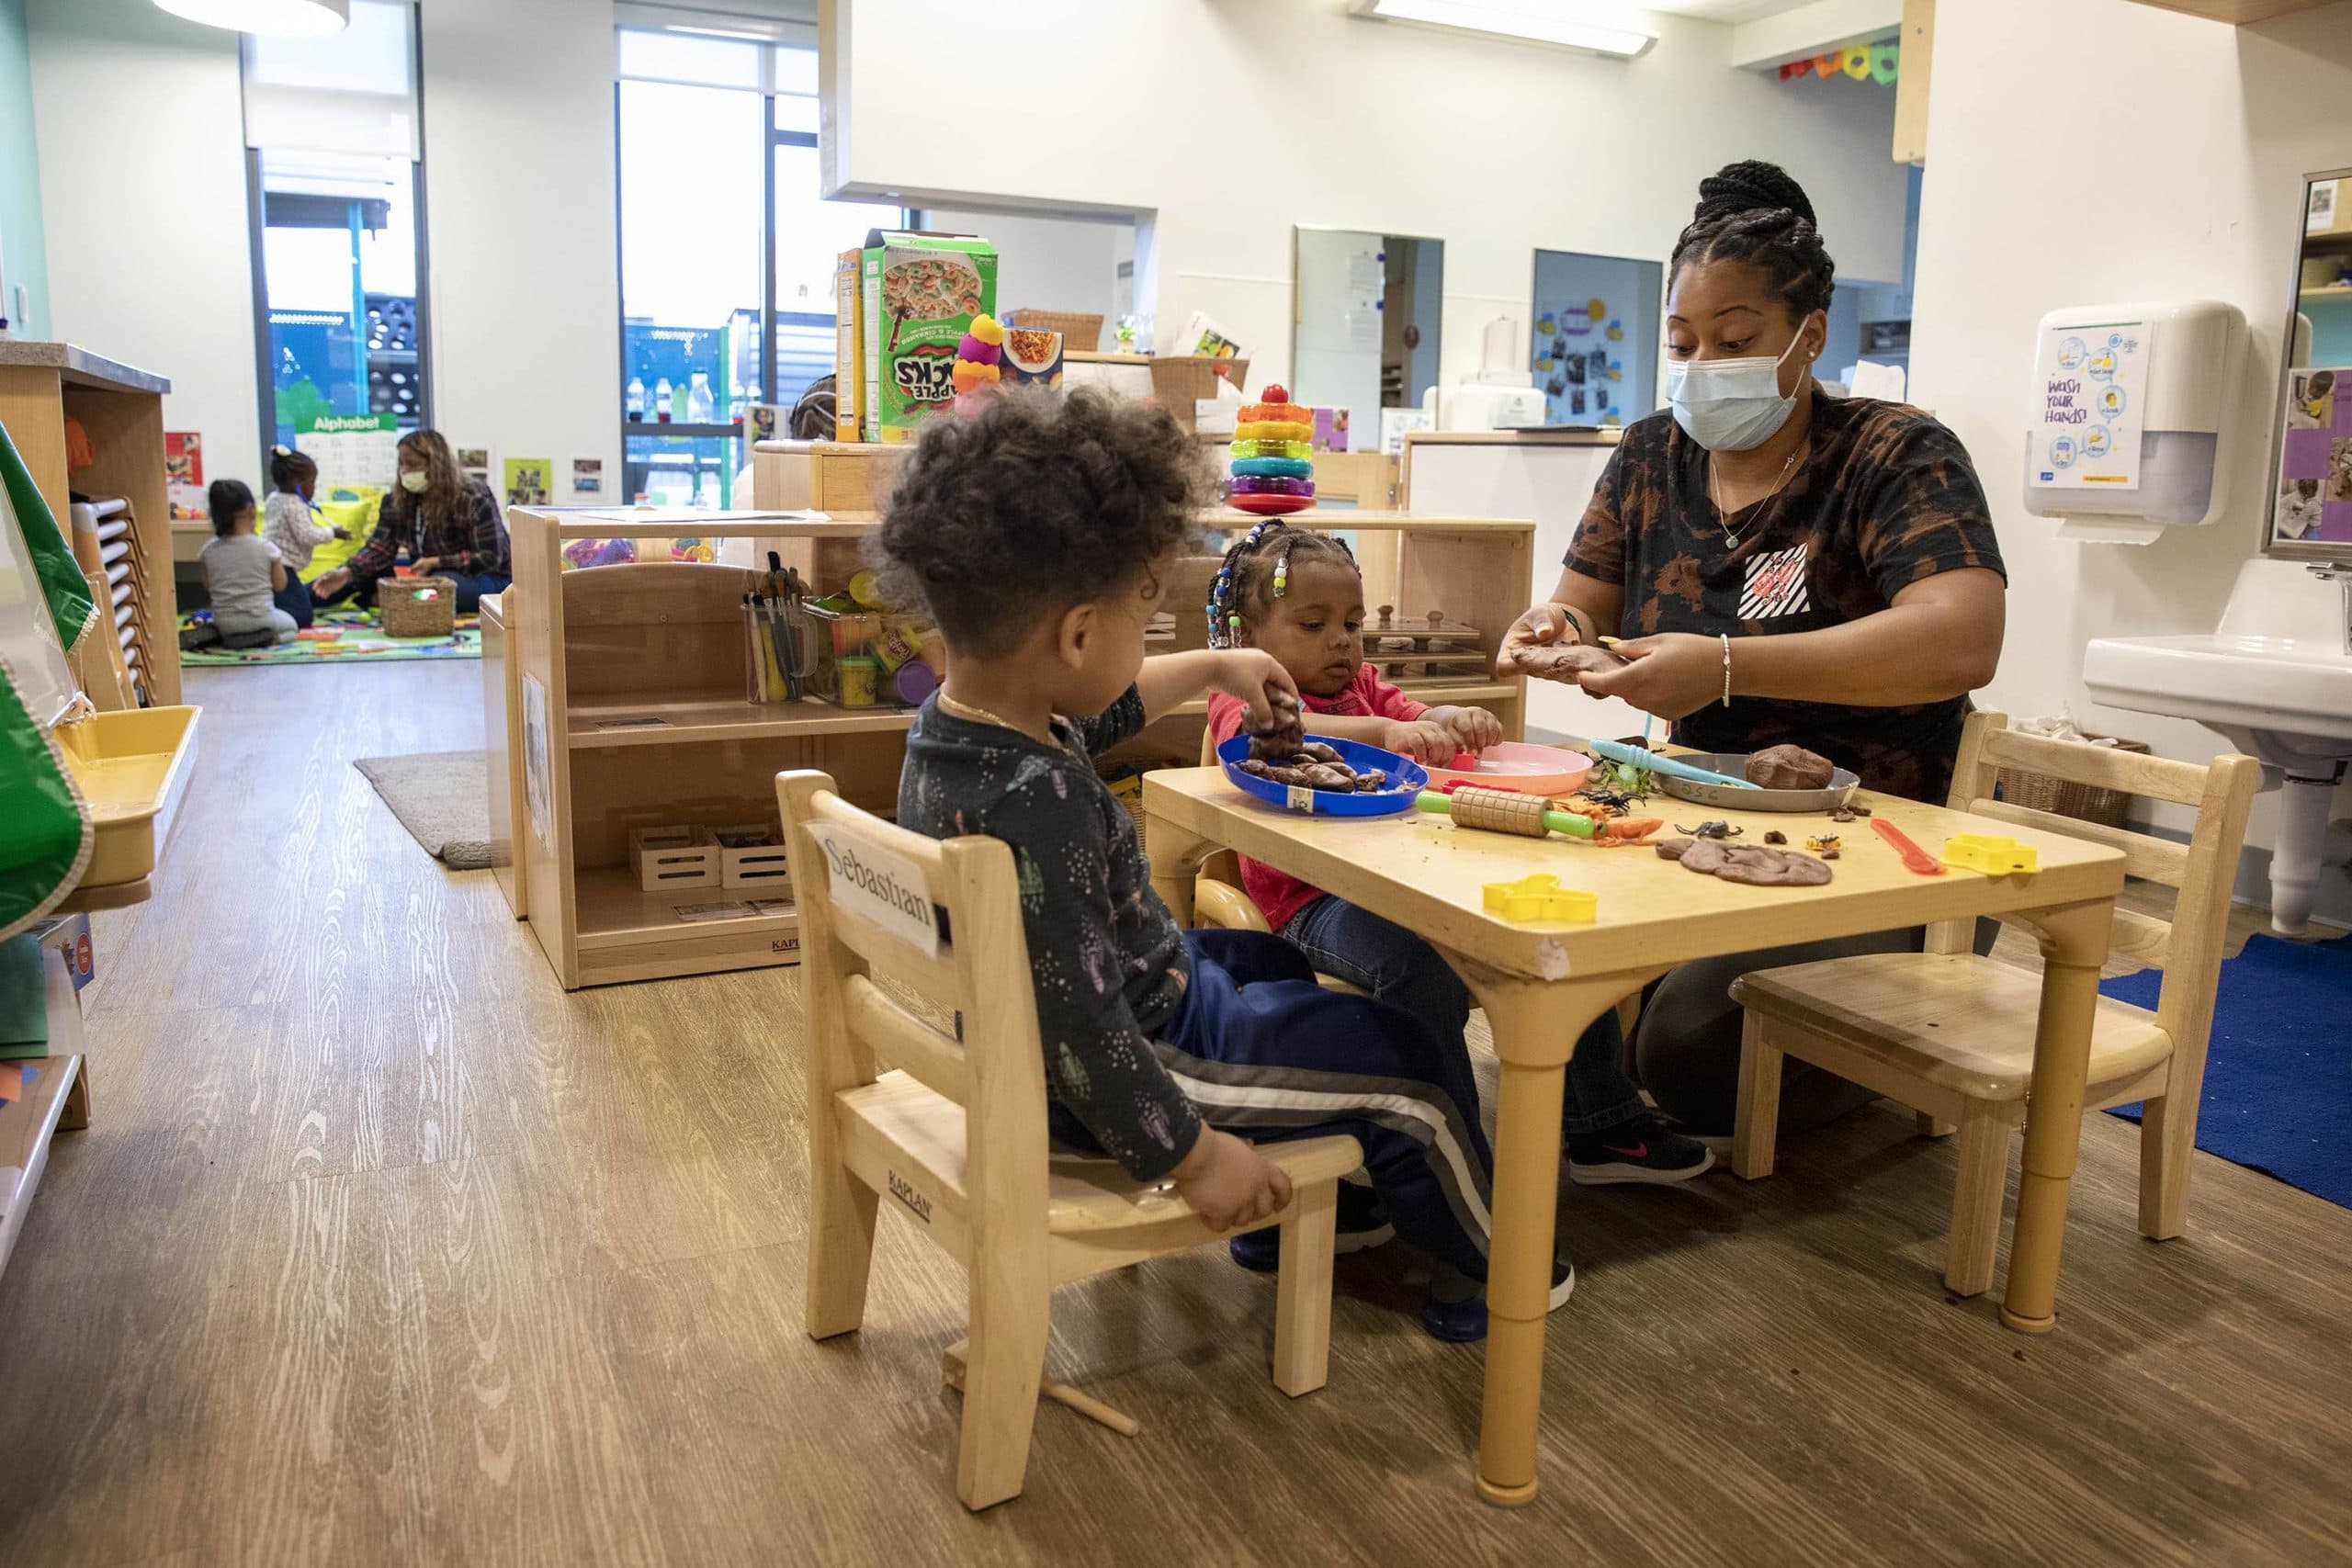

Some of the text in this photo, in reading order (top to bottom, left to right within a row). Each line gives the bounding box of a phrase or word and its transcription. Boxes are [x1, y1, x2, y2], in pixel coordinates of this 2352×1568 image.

[2046, 395, 2074, 409] YOUR
[313, 416, 380, 433] Alphabet
[824, 838, 930, 926] Sebastian
[888, 1168, 931, 1216] KAPLAN
